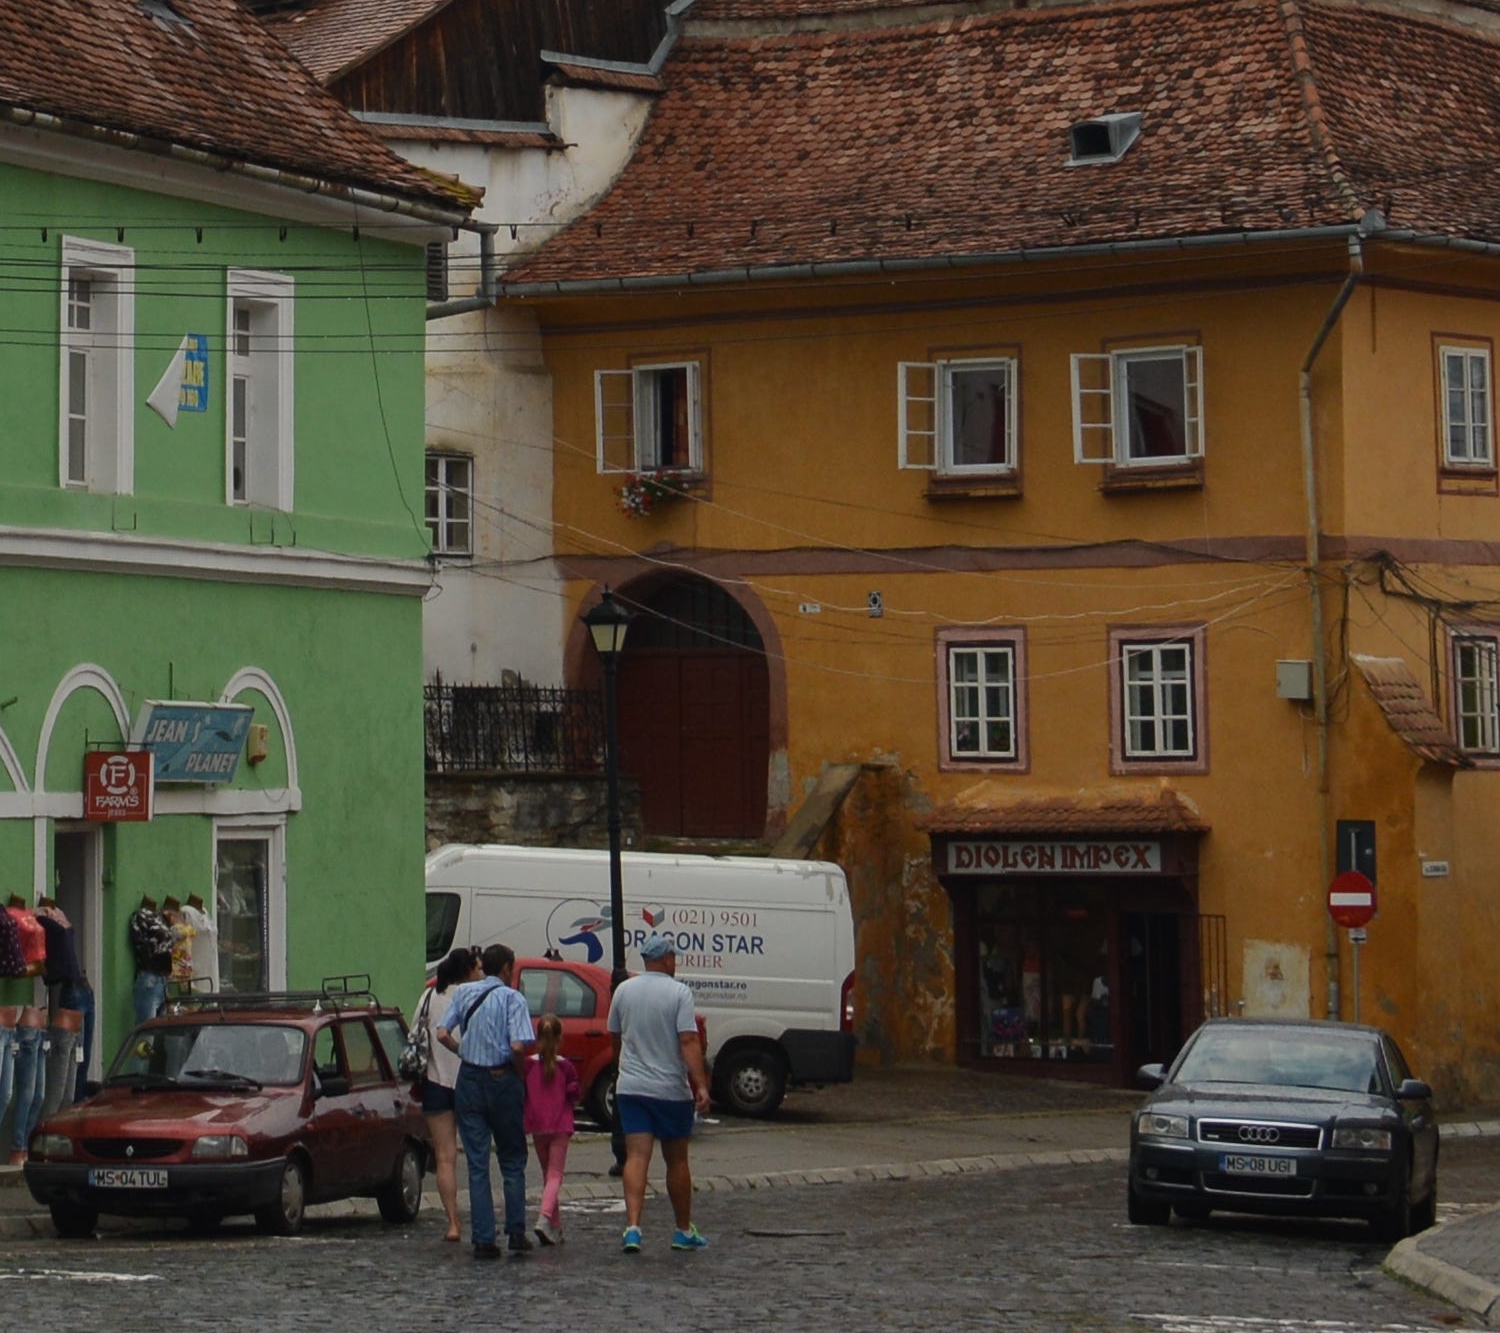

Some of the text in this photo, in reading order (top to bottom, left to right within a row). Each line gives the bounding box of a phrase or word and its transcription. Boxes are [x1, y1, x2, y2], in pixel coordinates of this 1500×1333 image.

[184, 753, 237, 774] PLANET
[954, 844, 1152, 870] DIOLEN IMPEX
[672, 909, 758, 928] (021) 9501
[712, 933, 764, 955] STAR
[1226, 1156, 1291, 1173] MS 08 UGI
[97, 1171, 165, 1186] MS 04 TUL
